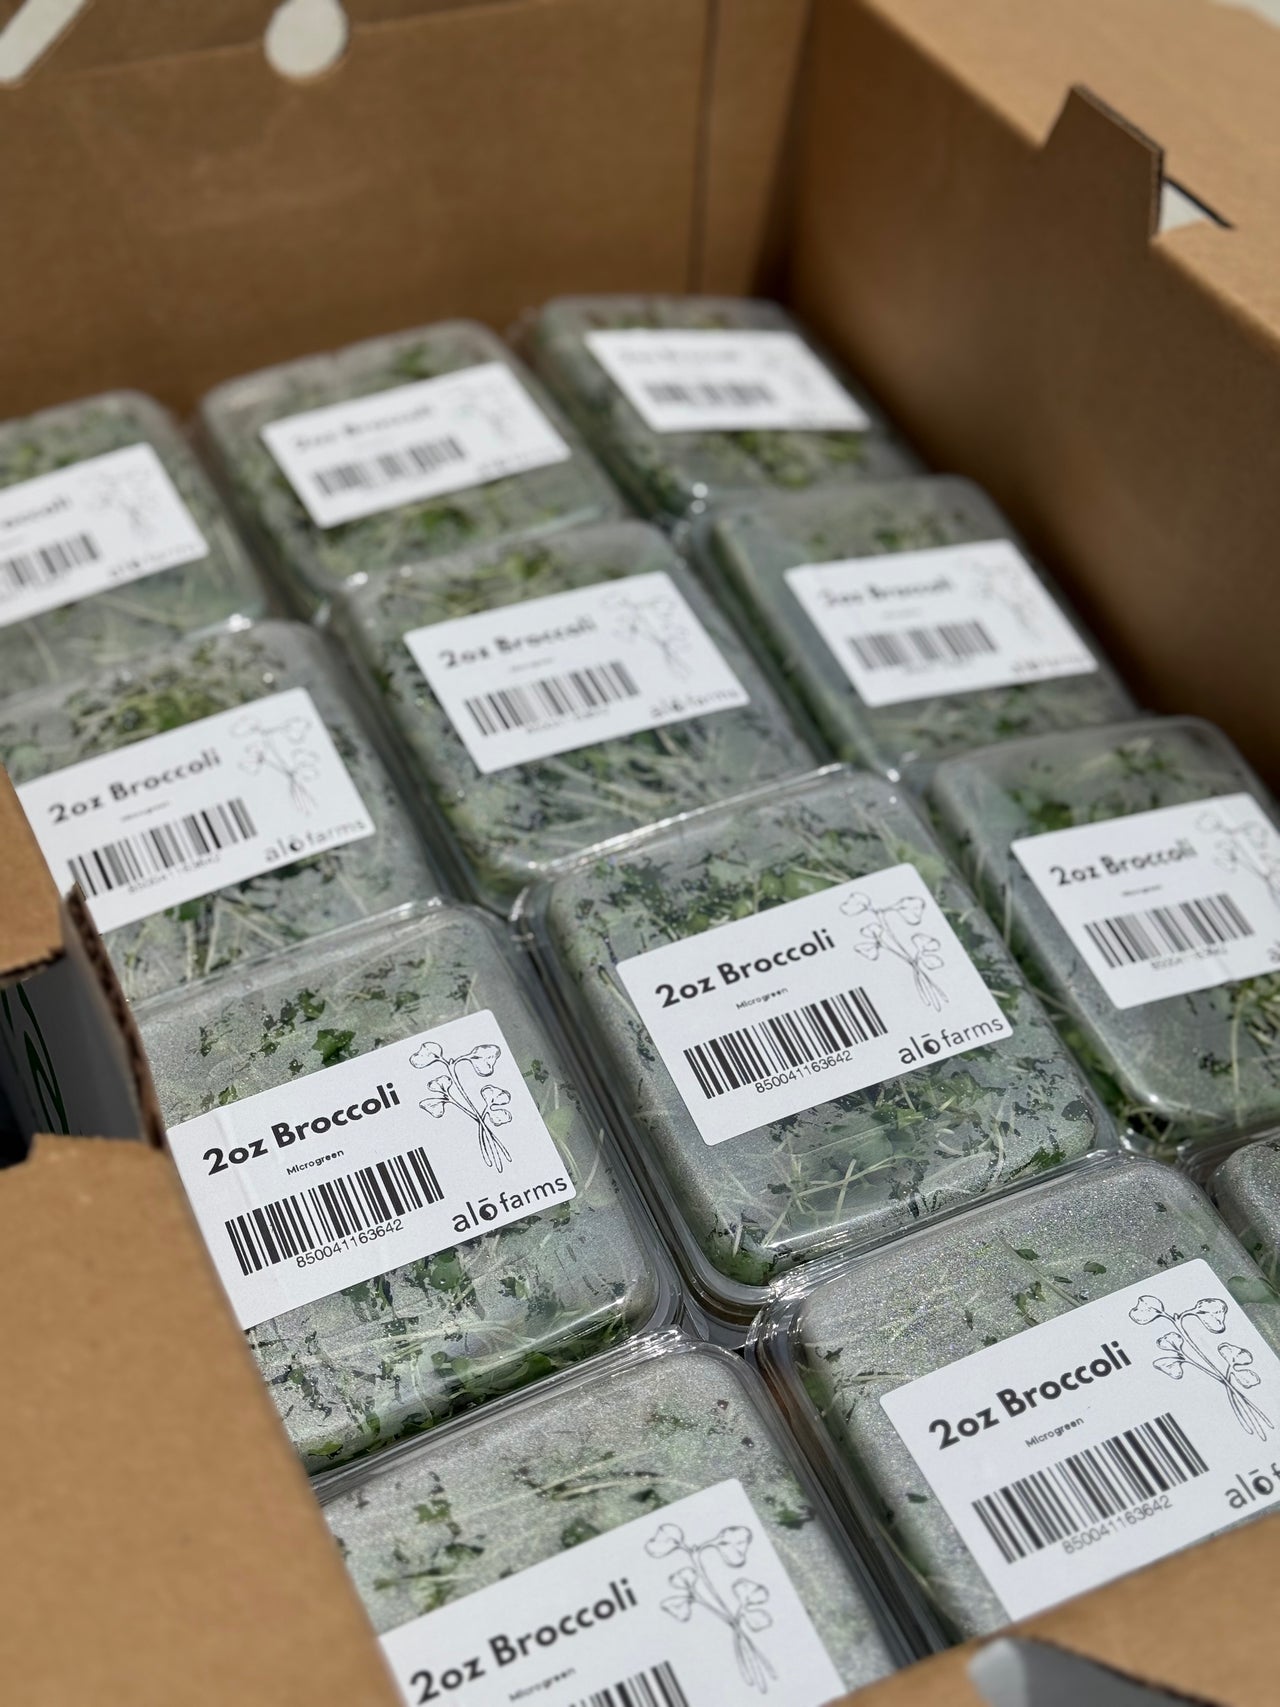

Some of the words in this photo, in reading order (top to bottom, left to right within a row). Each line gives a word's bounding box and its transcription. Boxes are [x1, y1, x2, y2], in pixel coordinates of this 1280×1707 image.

[48, 793, 104, 825] 2oz
[109, 748, 221, 801] Broccoli
[1049, 865, 1101, 887] 2oz
[1100, 838, 1197, 875] Broccoli
[655, 976, 716, 1009] 2oz
[716, 928, 836, 985] Broccoli
[735, 987, 788, 1010] Microgreen
[756, 1050, 853, 1094] 850041163642
[202, 1138, 268, 1176] 2oz
[271, 1082, 400, 1149] Broccoli
[286, 1150, 345, 1176] Microgreen
[296, 1218, 404, 1269] 850041163642
[928, 1407, 1000, 1450] 2oz
[995, 1340, 1132, 1418] Broccoli
[1024, 1417, 1085, 1448] Microgreen
[1061, 1494, 1174, 1555] 850041163642
[409, 1656, 487, 1706] 2oz
[487, 1577, 638, 1669] Broccoli
